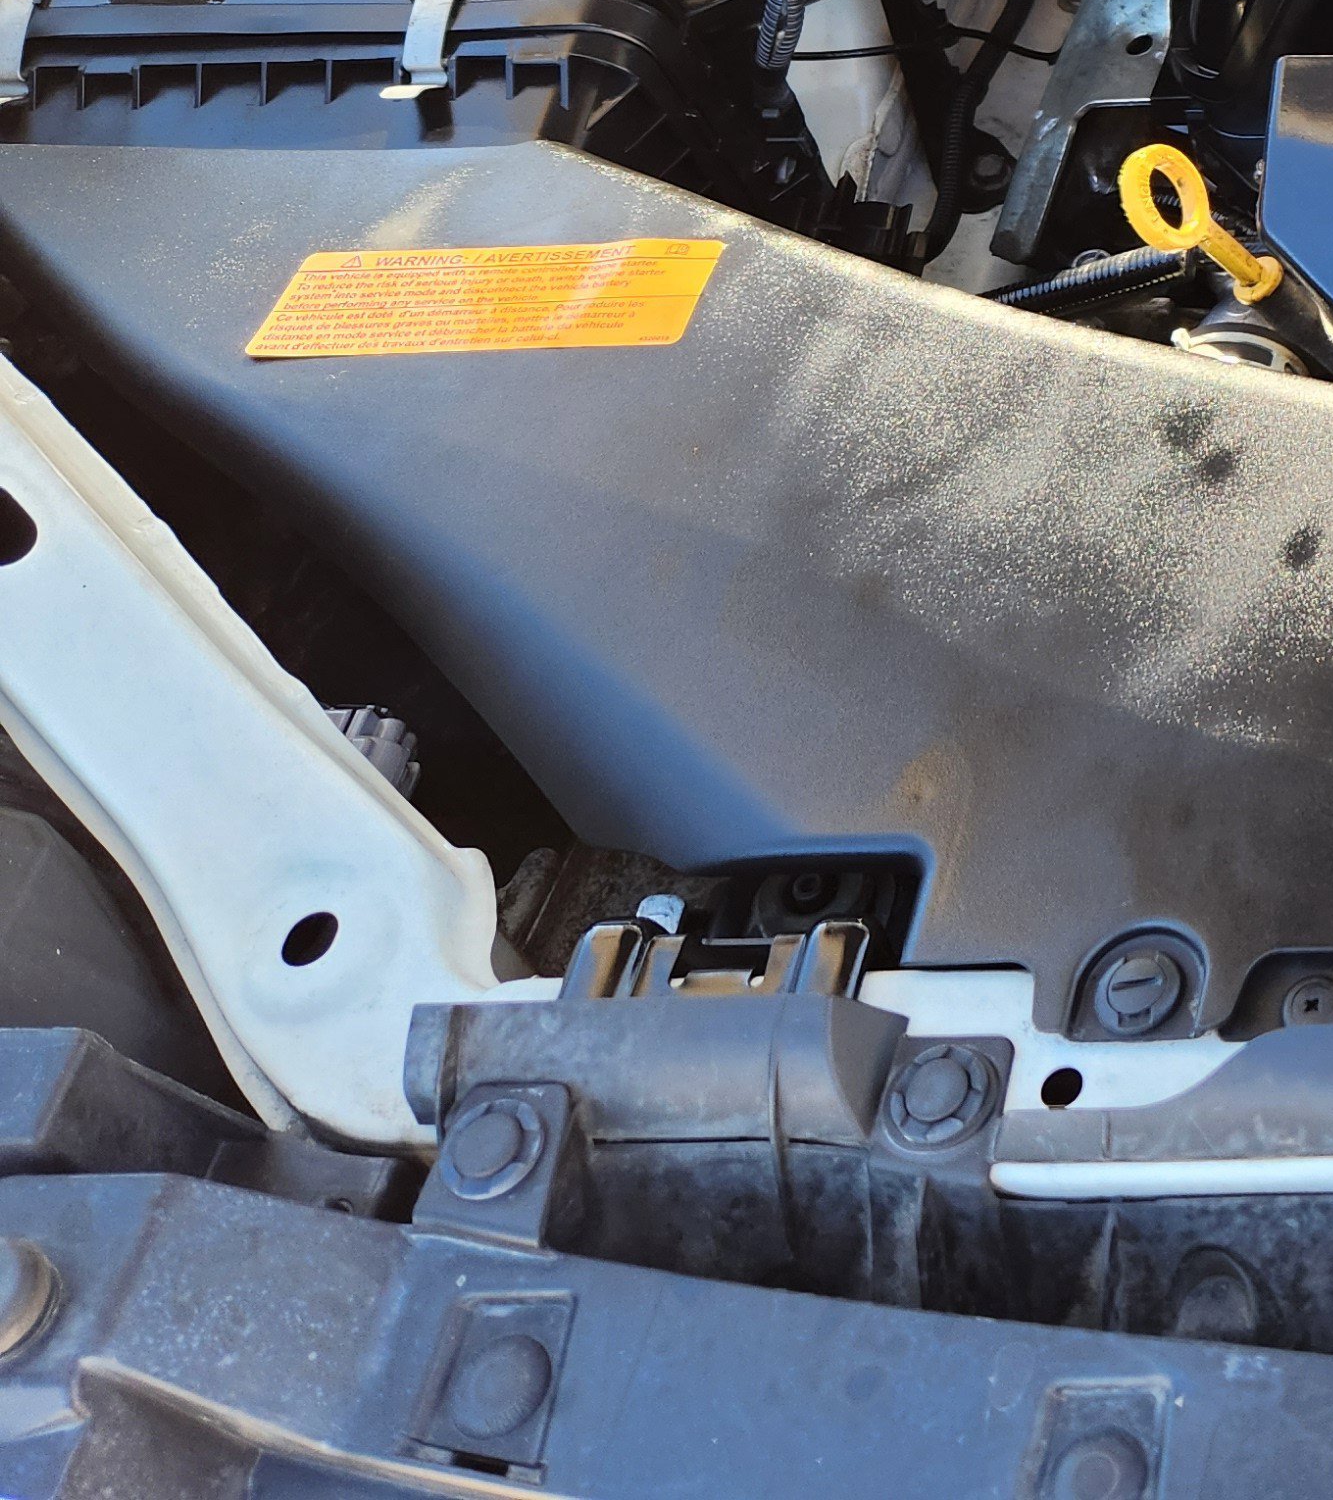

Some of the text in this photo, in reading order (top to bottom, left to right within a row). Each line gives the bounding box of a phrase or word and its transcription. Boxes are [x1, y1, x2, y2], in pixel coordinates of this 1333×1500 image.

[375, 254, 471, 266] WARNING:
[484, 245, 636, 263] AVERTISSEMENT
[330, 272, 372, 280] vehicle
[386, 270, 441, 279] equipped
[479, 267, 520, 275] remote
[522, 264, 580, 273] controlled
[296, 282, 313, 290] To
[313, 281, 355, 289] reduce
[356, 280, 376, 288] the
[416, 278, 460, 286] serious
[461, 276, 497, 285] injury
[550, 273, 587, 281] switch
[289, 292, 333, 301] system
[361, 289, 403, 298] service
[404, 288, 438, 296] mode
[464, 285, 528, 294] disconnect
[551, 281, 591, 290] vehicle
[276, 313, 295, 321] Ce
[295, 311, 347, 321] véhicule
[347, 311, 366, 319] est
[368, 310, 396, 318] doté
[399, 309, 427, 317] d'un
[555, 302, 582, 311] Pour
[628, 299, 647, 307] les
[284, 301, 323, 309] before
[323, 299, 389, 310] performing
[390, 300, 412, 308] any
[415, 297, 457, 306] service
[268, 323, 315, 332] risques
[334, 320, 392, 329] blessures
[393, 319, 434, 329] graves
[514, 314, 551, 322] mettre
[263, 331, 315, 341] distance
[334, 330, 369, 338] mode
[370, 328, 413, 337] service
[415, 328, 429, 336] et
[498, 325, 509, 333] la
[255, 342, 291, 351] avant
[358, 339, 382, 348] des
[383, 338, 428, 347] travaux
